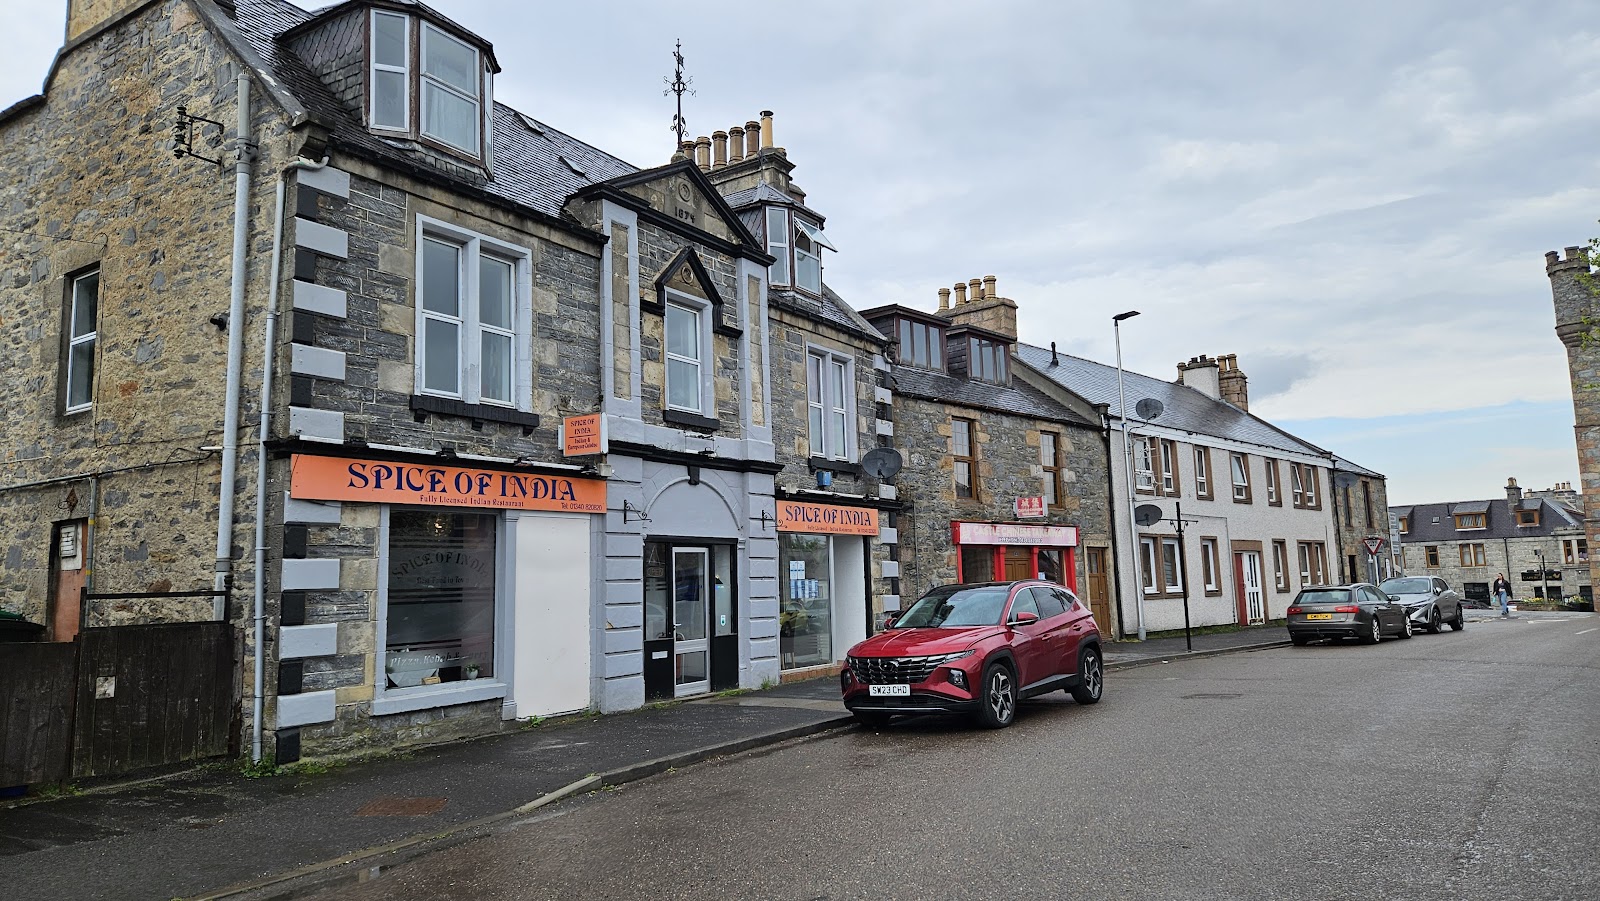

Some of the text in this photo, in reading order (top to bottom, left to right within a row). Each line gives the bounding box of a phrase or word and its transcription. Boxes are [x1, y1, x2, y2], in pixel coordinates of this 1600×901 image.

[570, 419, 587, 427] SPICE
[574, 427, 591, 435] INDIA
[347, 462, 577, 501] SPICE OF INDIA
[420, 494, 524, 507] Fully Licensed Indian Restaurant
[569, 502, 584, 510] 01340
[785, 505, 872, 526] SPICE OF INDIA
[392, 553, 433, 579] SPICE
[435, 551, 453, 563] OF
[872, 686, 907, 694] SW23 CHD
